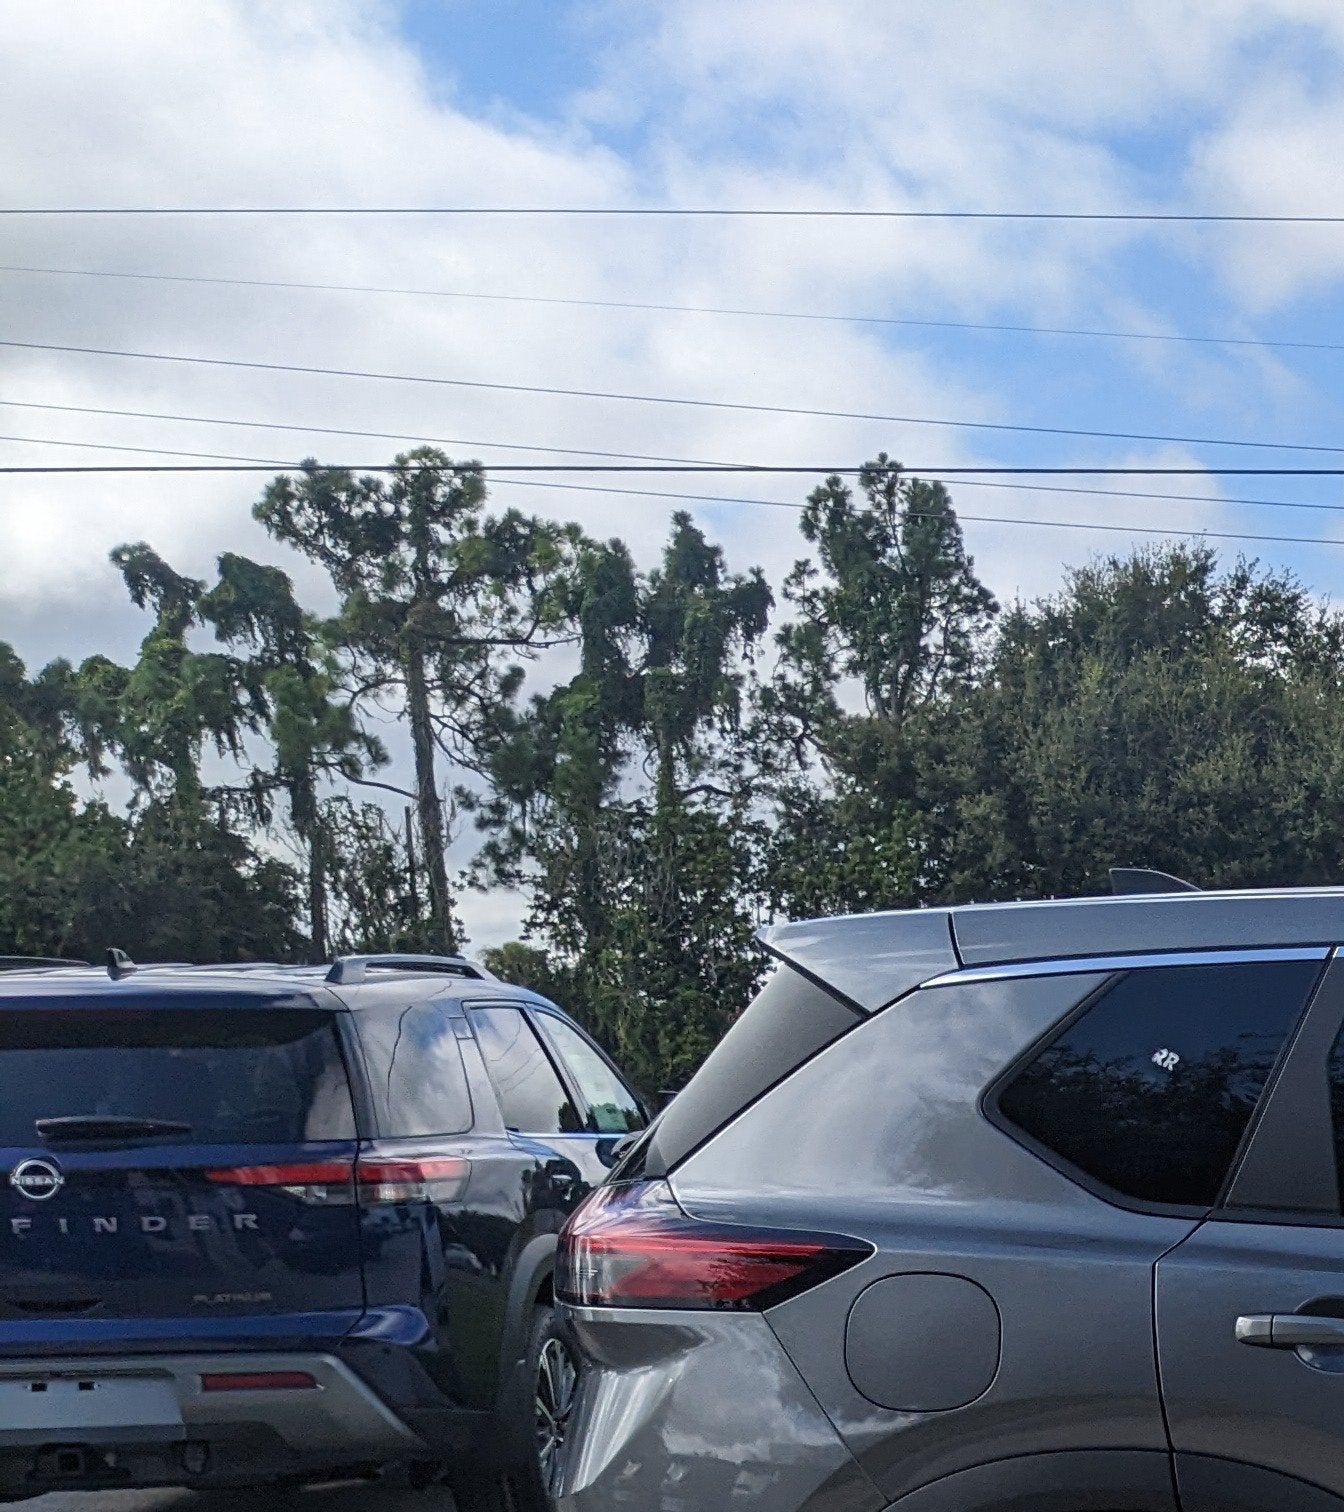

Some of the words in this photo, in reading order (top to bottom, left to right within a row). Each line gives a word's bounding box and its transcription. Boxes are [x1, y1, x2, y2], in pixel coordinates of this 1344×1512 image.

[1151, 1048, 1180, 1071] RR
[10, 1174, 65, 1186] NISSAN
[10, 1213, 259, 1235] FINDER
